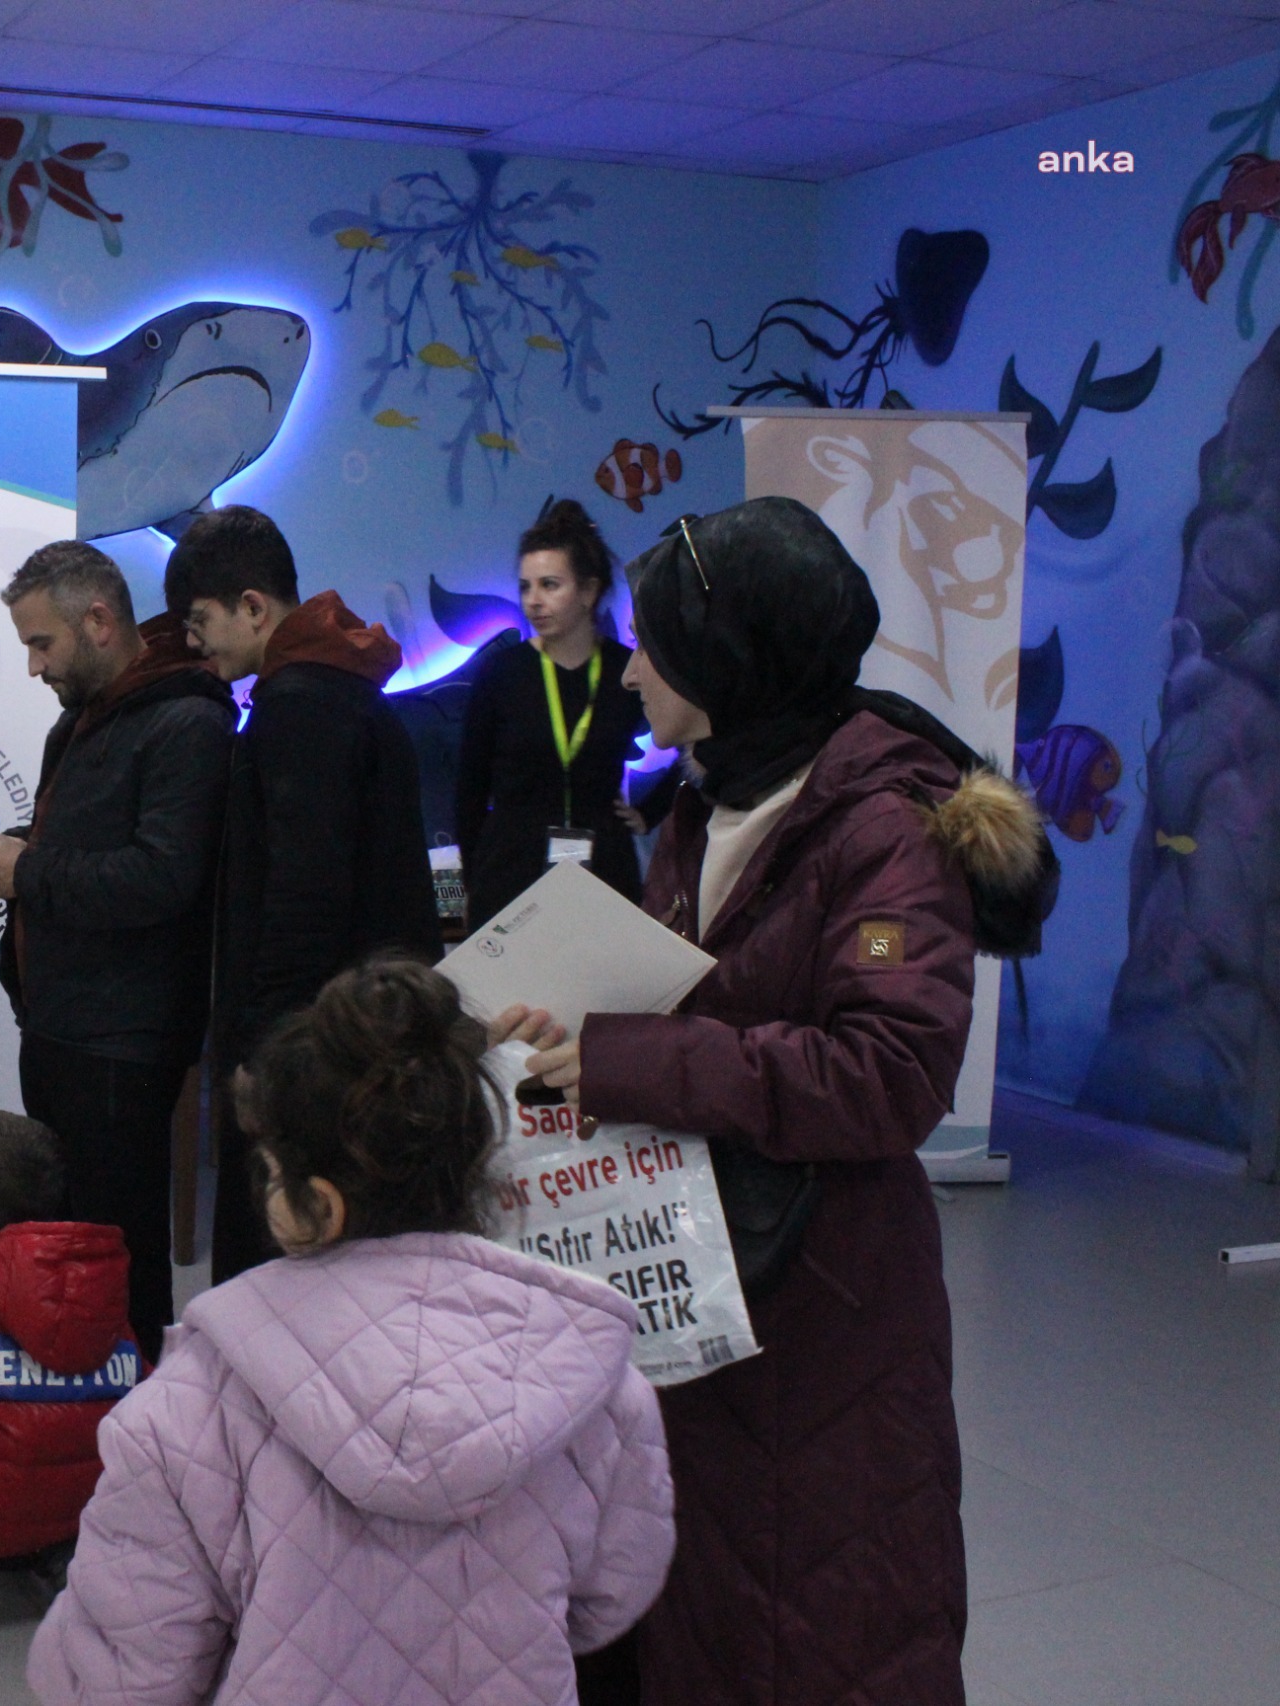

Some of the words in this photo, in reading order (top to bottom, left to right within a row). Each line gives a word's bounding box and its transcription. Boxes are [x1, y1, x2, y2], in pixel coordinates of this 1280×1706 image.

[539, 1155, 619, 1208] çevre
[624, 1135, 684, 1184] için
[608, 1259, 692, 1300] SIFIR
[636, 1292, 698, 1335] TIK
